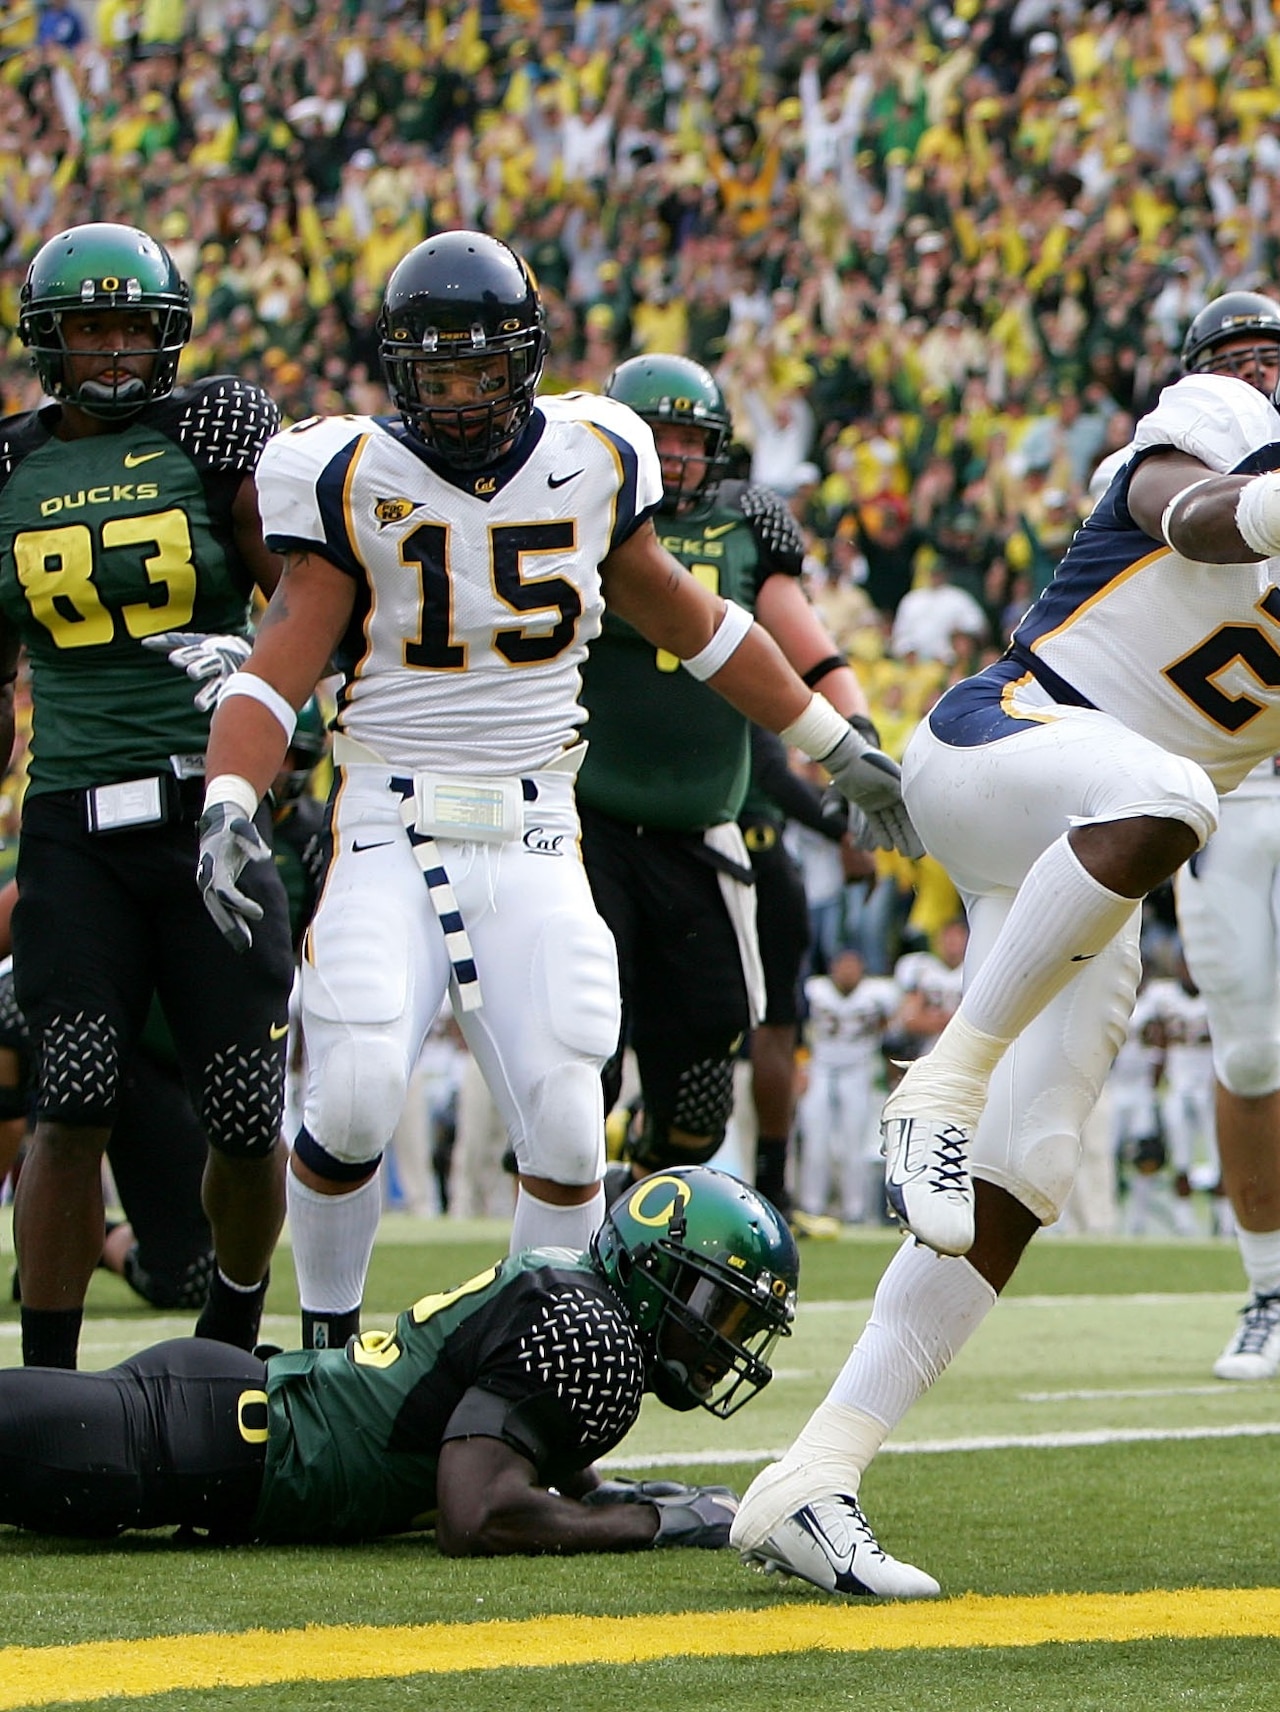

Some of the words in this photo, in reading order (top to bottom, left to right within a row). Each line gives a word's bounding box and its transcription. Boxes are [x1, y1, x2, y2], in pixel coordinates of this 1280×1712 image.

[102, 276, 119, 293] O
[40, 483, 158, 517] DUCKS
[474, 477, 496, 494] Cal
[12, 506, 198, 650] 83
[398, 517, 584, 672] 15
[523, 827, 563, 857] Cal
[628, 1175, 692, 1227] O
